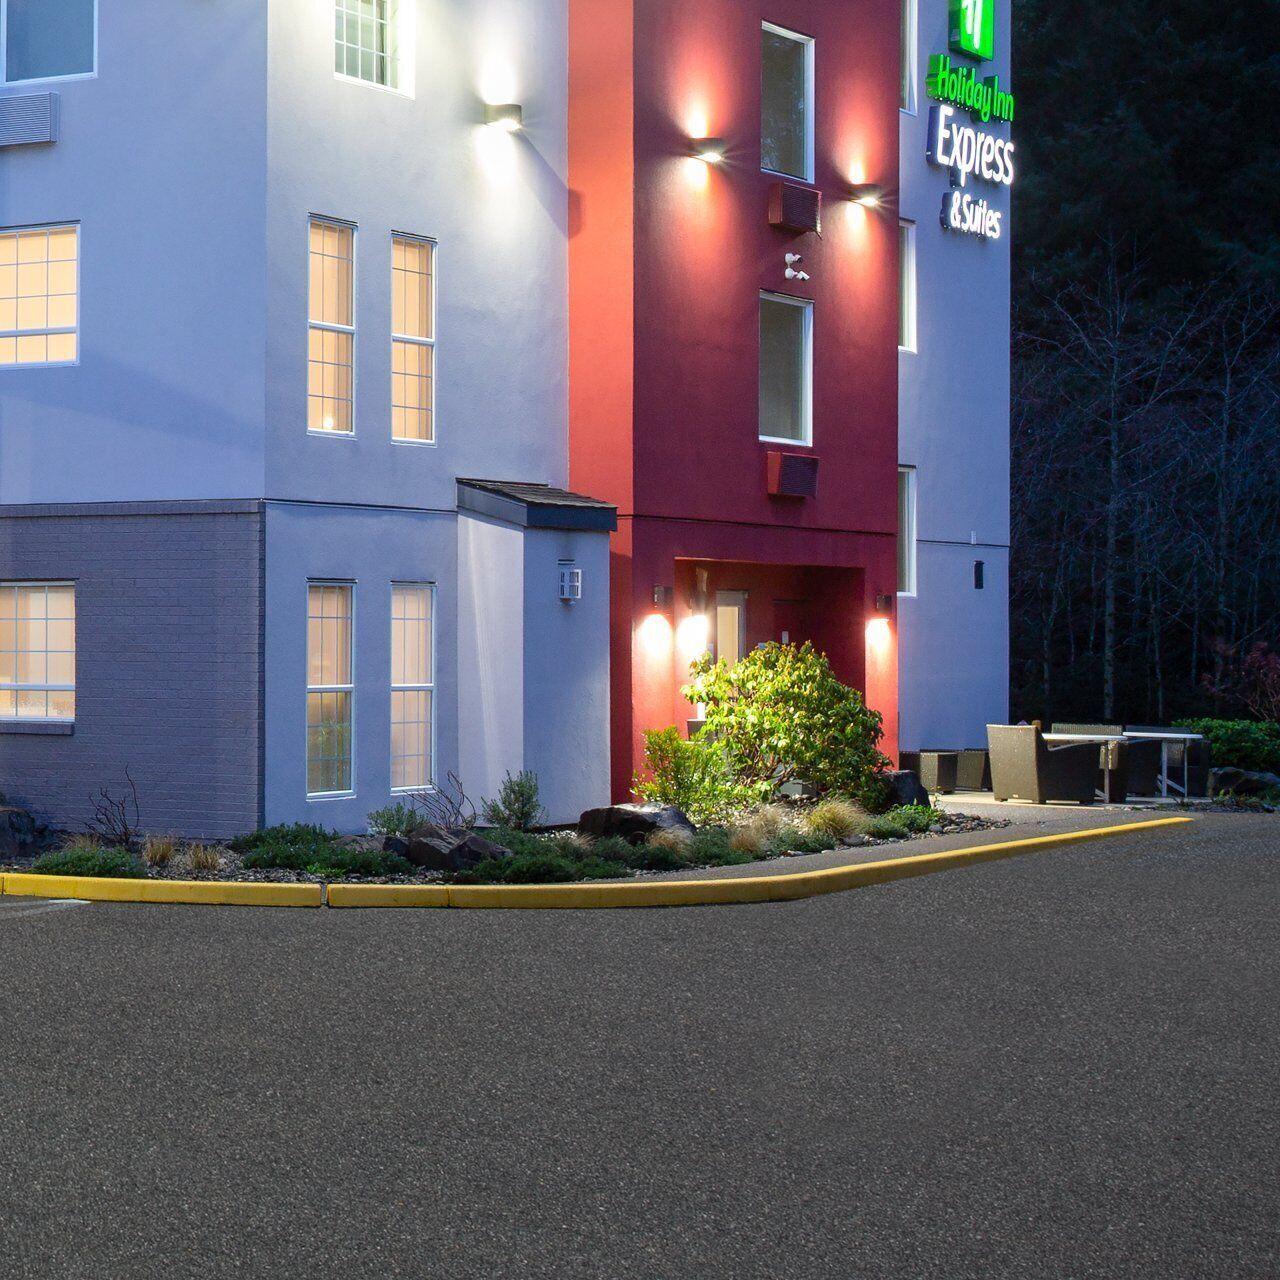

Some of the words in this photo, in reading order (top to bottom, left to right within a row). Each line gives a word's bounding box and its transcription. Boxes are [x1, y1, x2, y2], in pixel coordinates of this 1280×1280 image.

[937, 54, 992, 122] Holiday
[993, 75, 1015, 122] Inn
[936, 104, 1015, 187] Express
